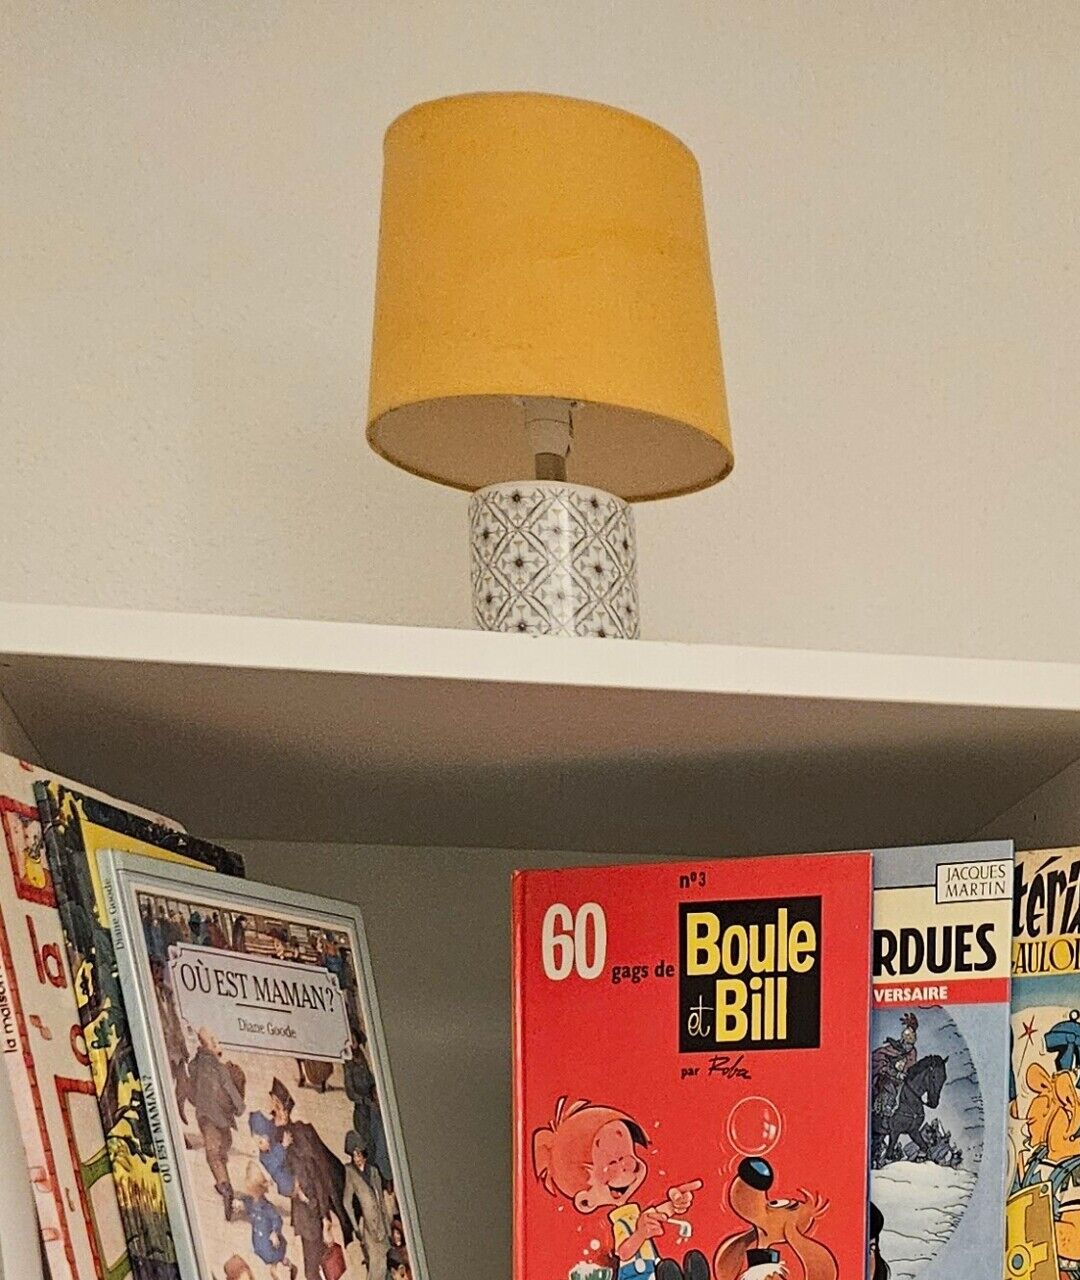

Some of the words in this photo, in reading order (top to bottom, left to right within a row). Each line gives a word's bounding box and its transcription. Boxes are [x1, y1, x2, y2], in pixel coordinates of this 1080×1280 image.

[946, 863, 1006, 882] JACQUES
[945, 880, 1006, 897] MARTIN
[541, 901, 607, 981] 60
[611, 962, 649, 984] gags
[654, 960, 675, 978] de
[686, 907, 817, 977] Boule
[873, 922, 997, 977] RDUES
[180, 958, 212, 994] OÙ
[213, 969, 248, 1001] EST
[873, 985, 948, 1002] VERSAIRE
[687, 994, 714, 1037] et
[715, 976, 788, 1042] Bill
[237, 1017, 265, 1035] Diane
[266, 1022, 297, 1039] Goode
[5, 1034, 18, 1053] la
[681, 1066, 699, 1079] par
[154, 1138, 168, 1164] EST
